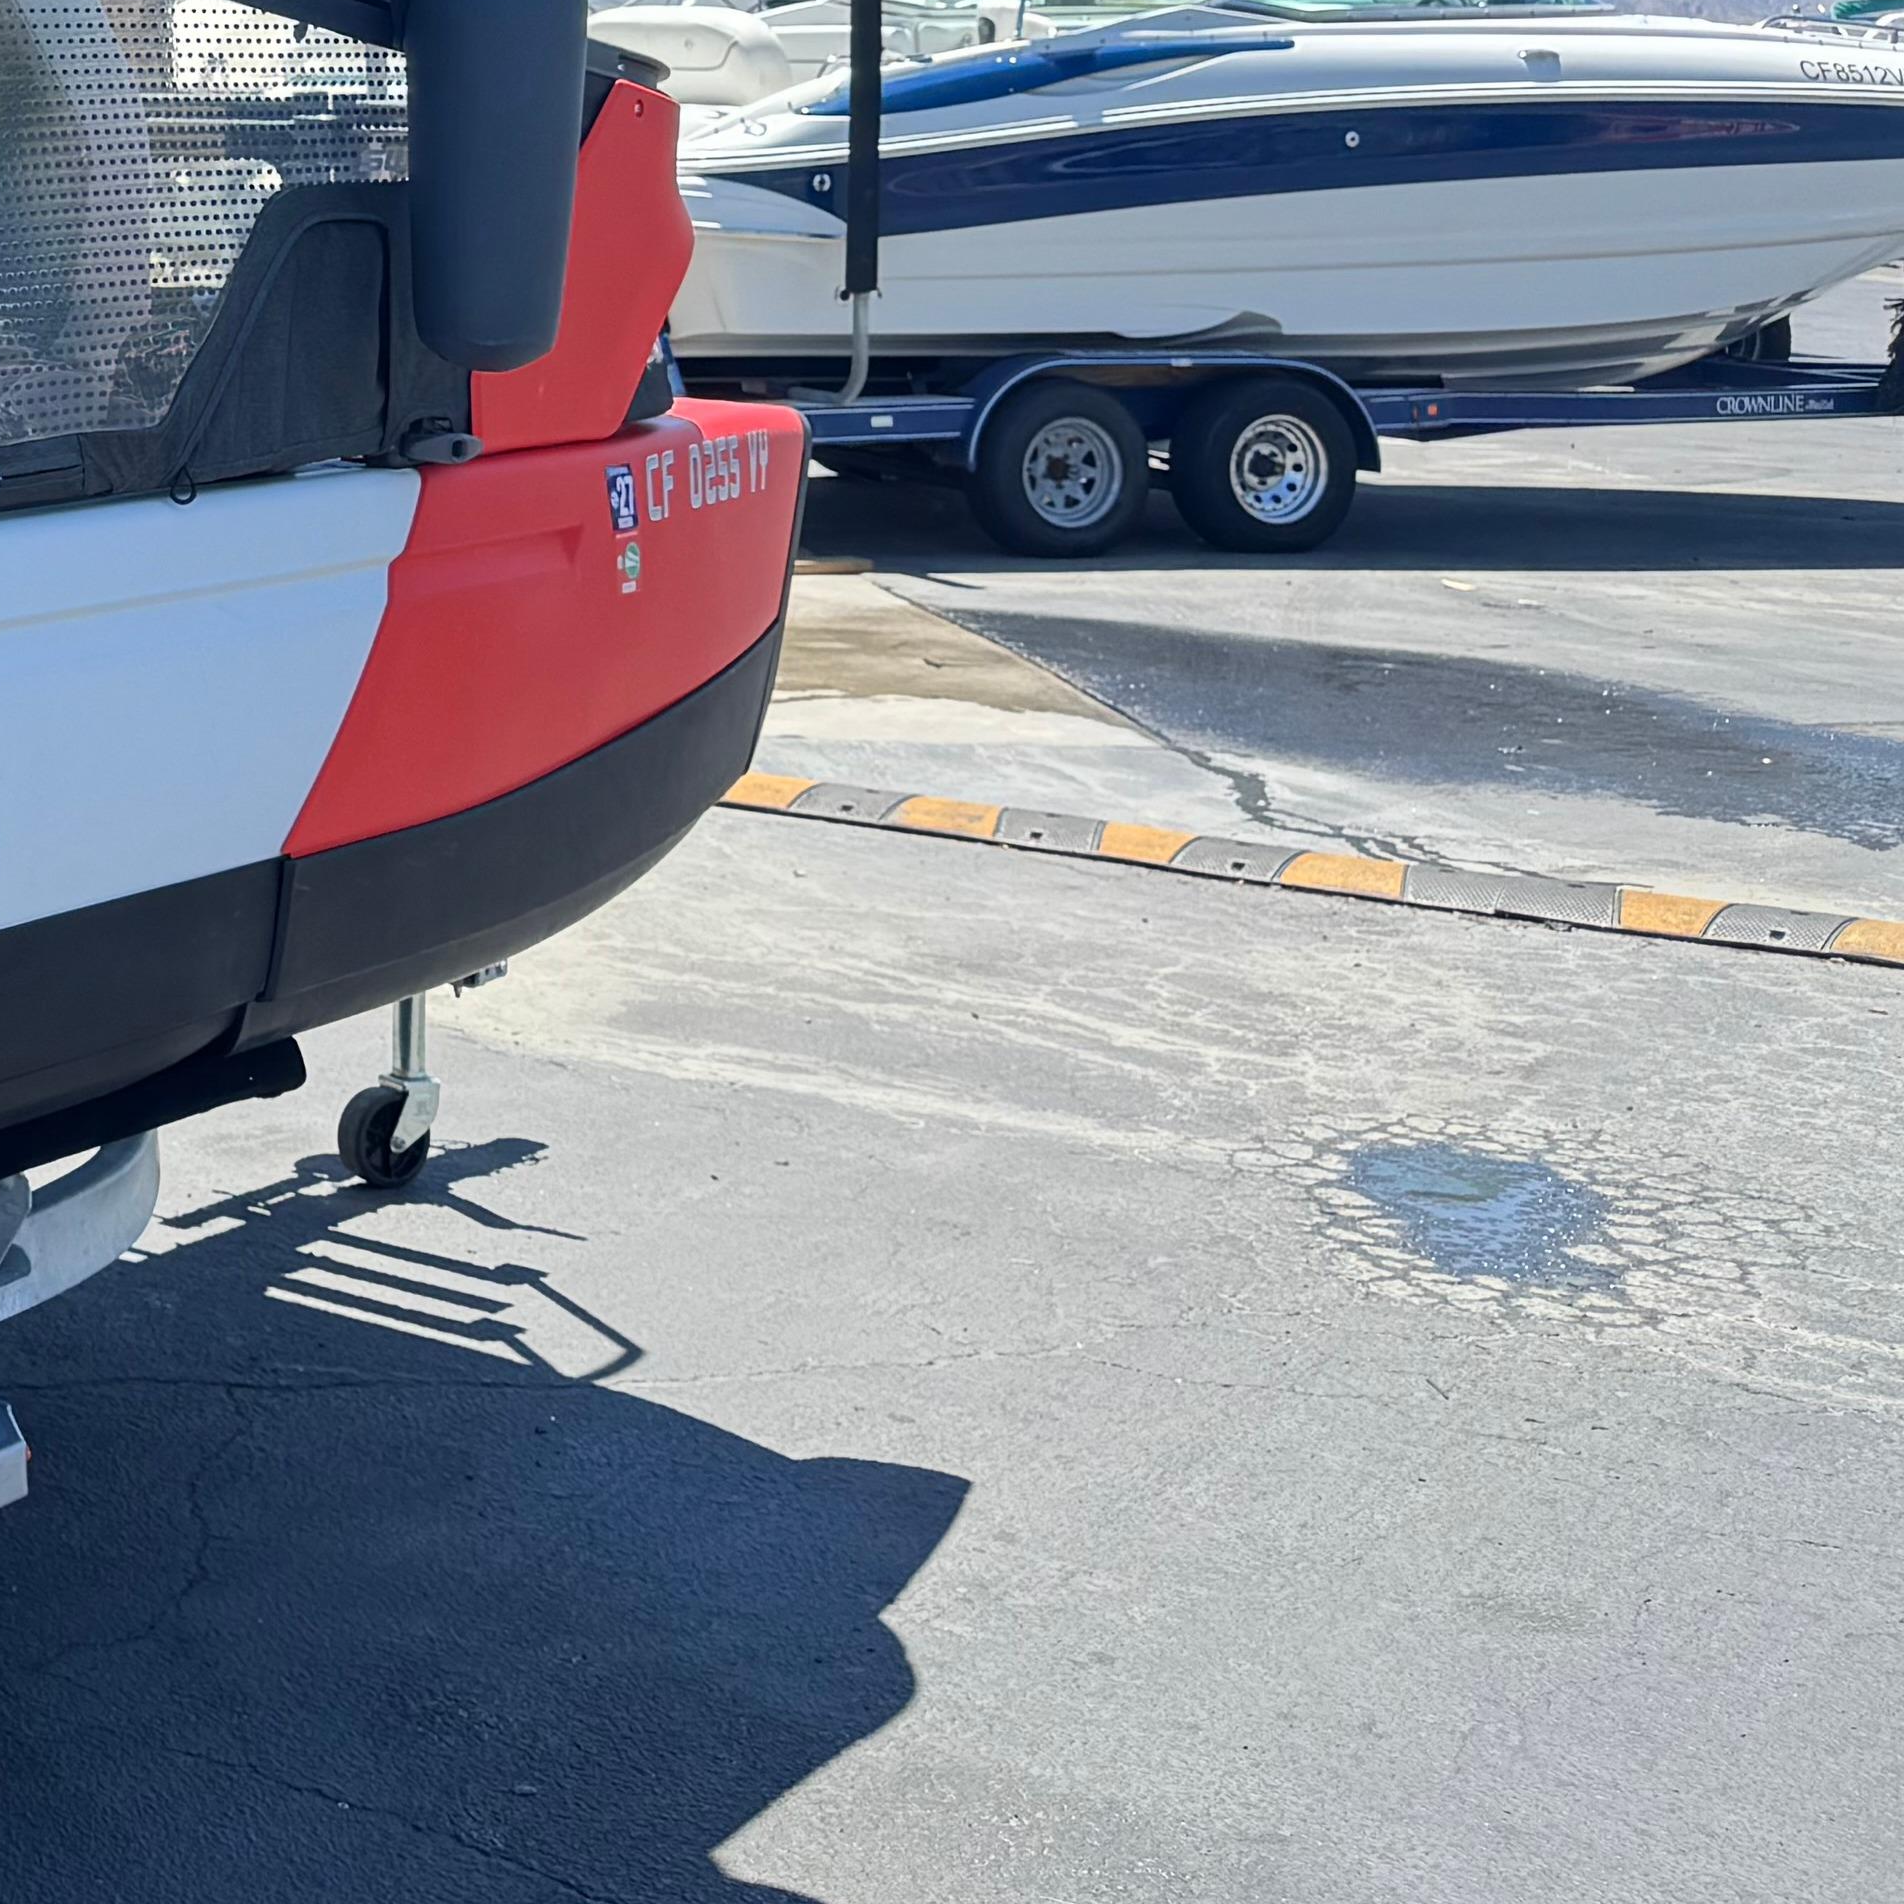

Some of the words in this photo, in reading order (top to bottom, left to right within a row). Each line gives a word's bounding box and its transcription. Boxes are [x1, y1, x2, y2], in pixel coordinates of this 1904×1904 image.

[1716, 394, 1804, 414] CROWNLINE
[616, 474, 634, 516] 27
[646, 449, 674, 522] CF
[689, 435, 741, 509] 0255
[747, 428, 769, 493] VY
